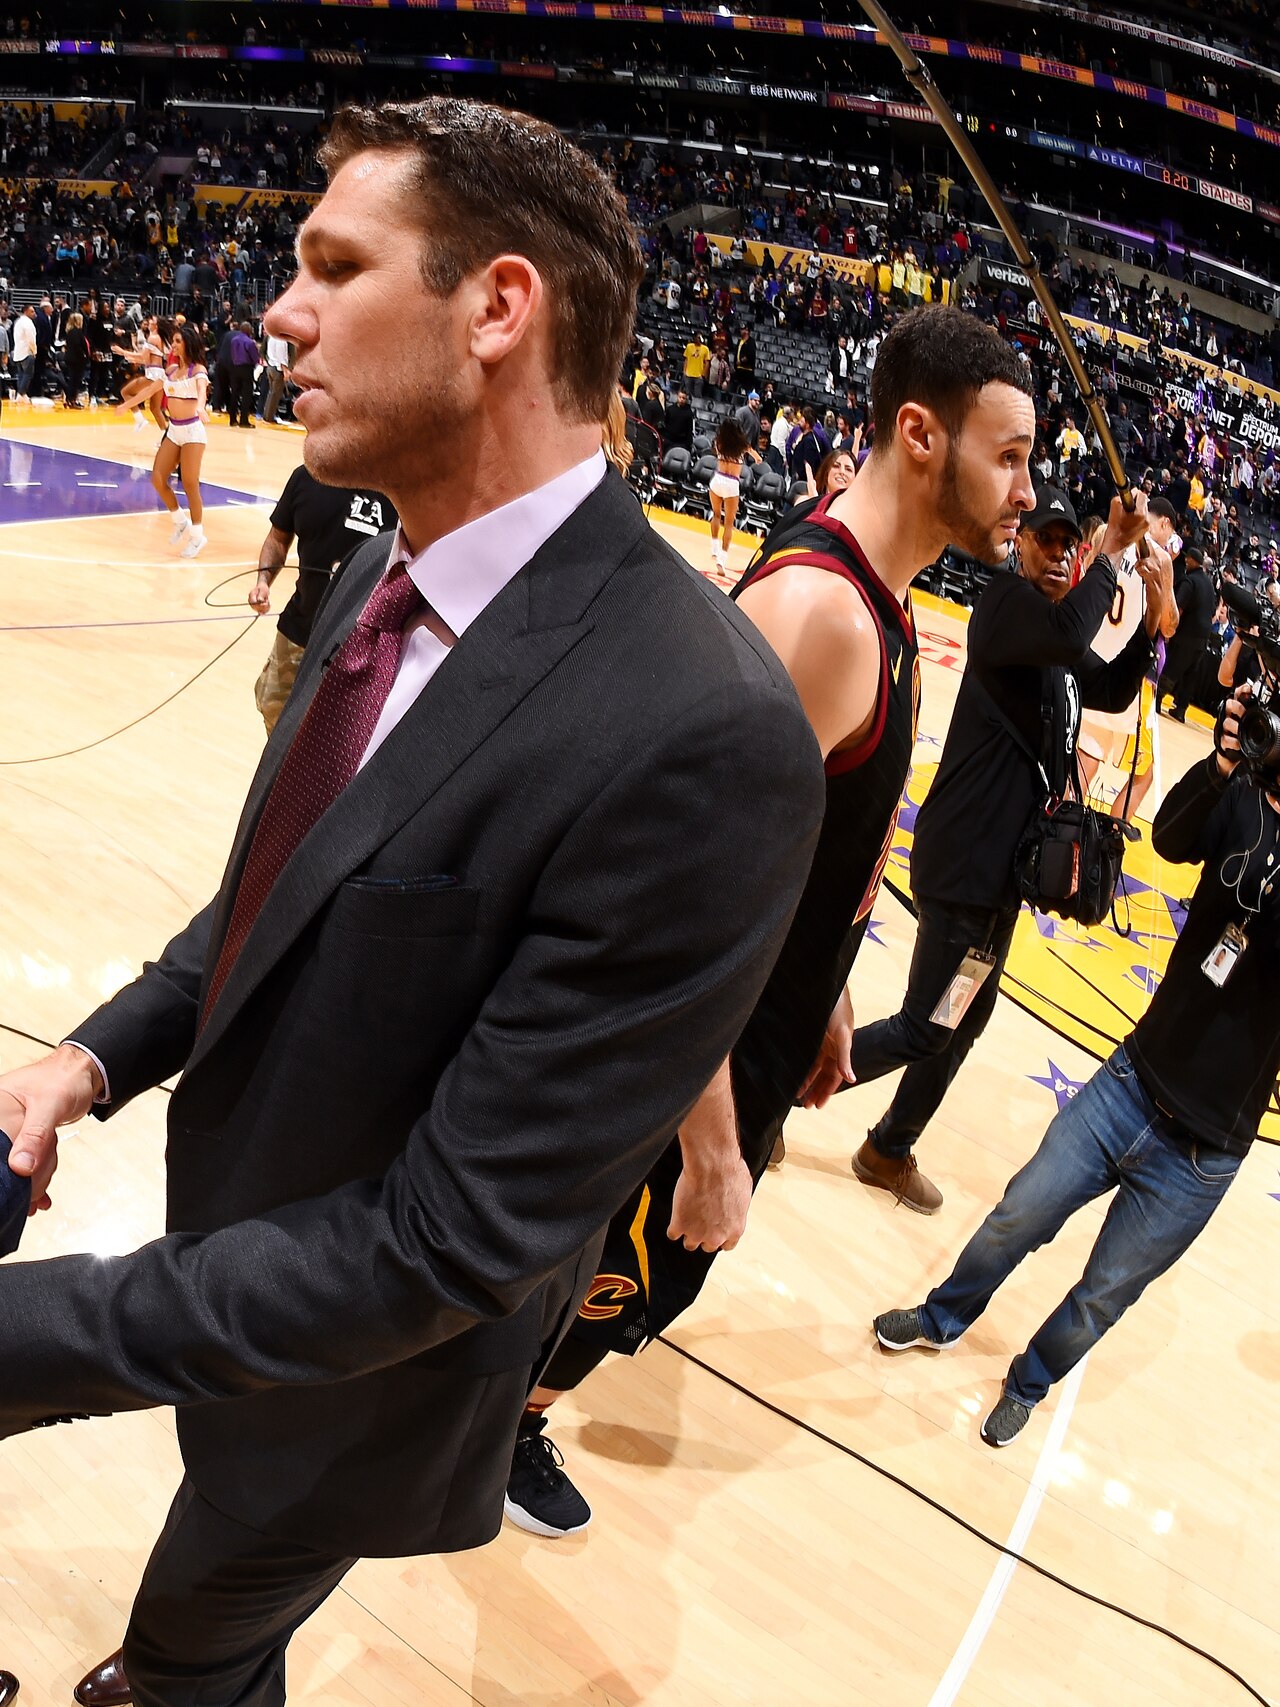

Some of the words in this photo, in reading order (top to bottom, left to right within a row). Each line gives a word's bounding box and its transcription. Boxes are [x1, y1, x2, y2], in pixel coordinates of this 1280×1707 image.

[312, 52, 363, 65] TOYOTA
[1210, 49, 1236, 68] 69050
[639, 76, 680, 89] verizon
[696, 80, 741, 95] StubHub
[770, 87, 818, 103] NETWORK
[1101, 152, 1142, 173] DELTA
[1200, 182, 1252, 212] STAPLES
[986, 264, 1031, 288] verizo
[1087, 361, 1162, 397] LARS.COM
[1164, 391, 1235, 429] SORNET
[1243, 413, 1278, 435] SPECTRUM
[350, 495, 385, 527] LA
